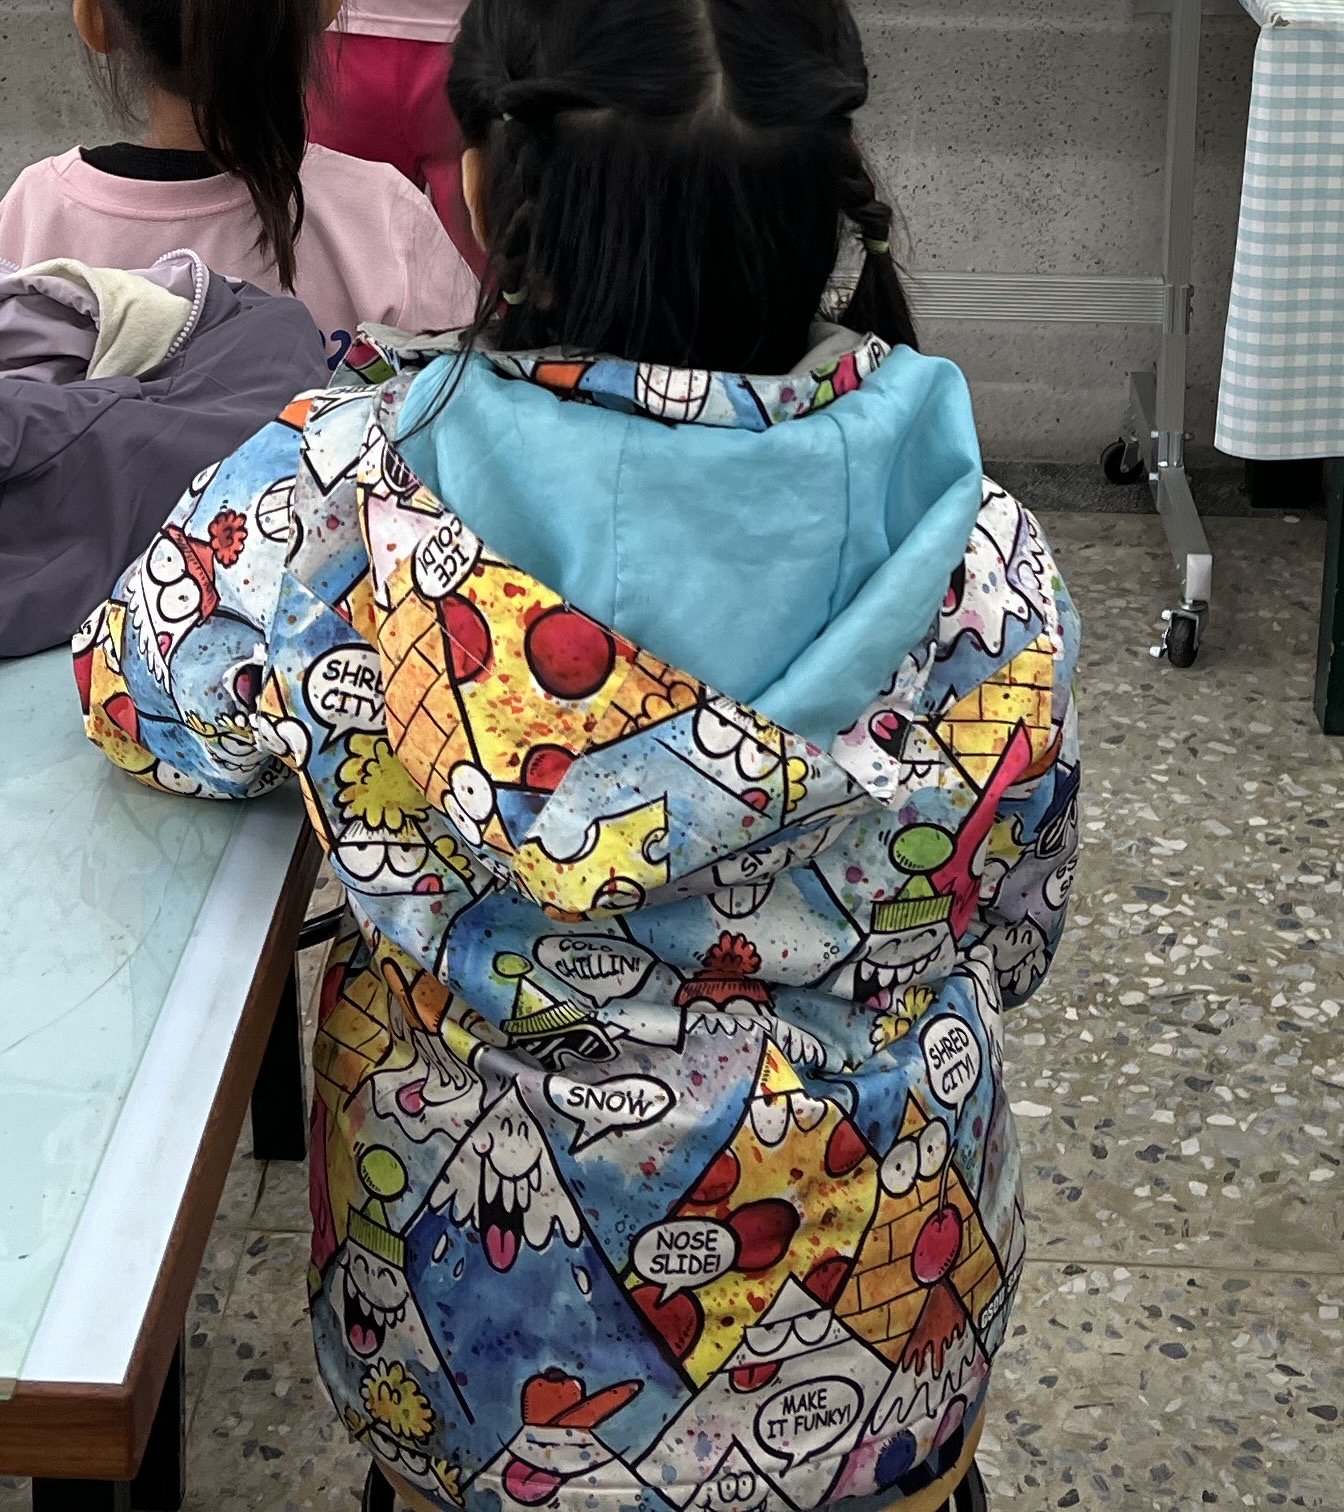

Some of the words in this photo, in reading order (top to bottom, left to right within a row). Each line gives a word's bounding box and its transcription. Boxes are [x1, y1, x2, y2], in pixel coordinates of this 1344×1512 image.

[433, 543, 470, 589] ICE
[554, 954, 642, 981] CHILLIN!
[929, 1029, 967, 1070] SHRED
[940, 1059, 976, 1095] CITY!
[566, 1086, 655, 1118] SNOW
[655, 1229, 719, 1253] NOSE
[649, 1252, 722, 1275] SLIDE!
[780, 1388, 829, 1416] MAKE
[766, 1417, 790, 1439] IT
[792, 1403, 853, 1435] FUNKY!
